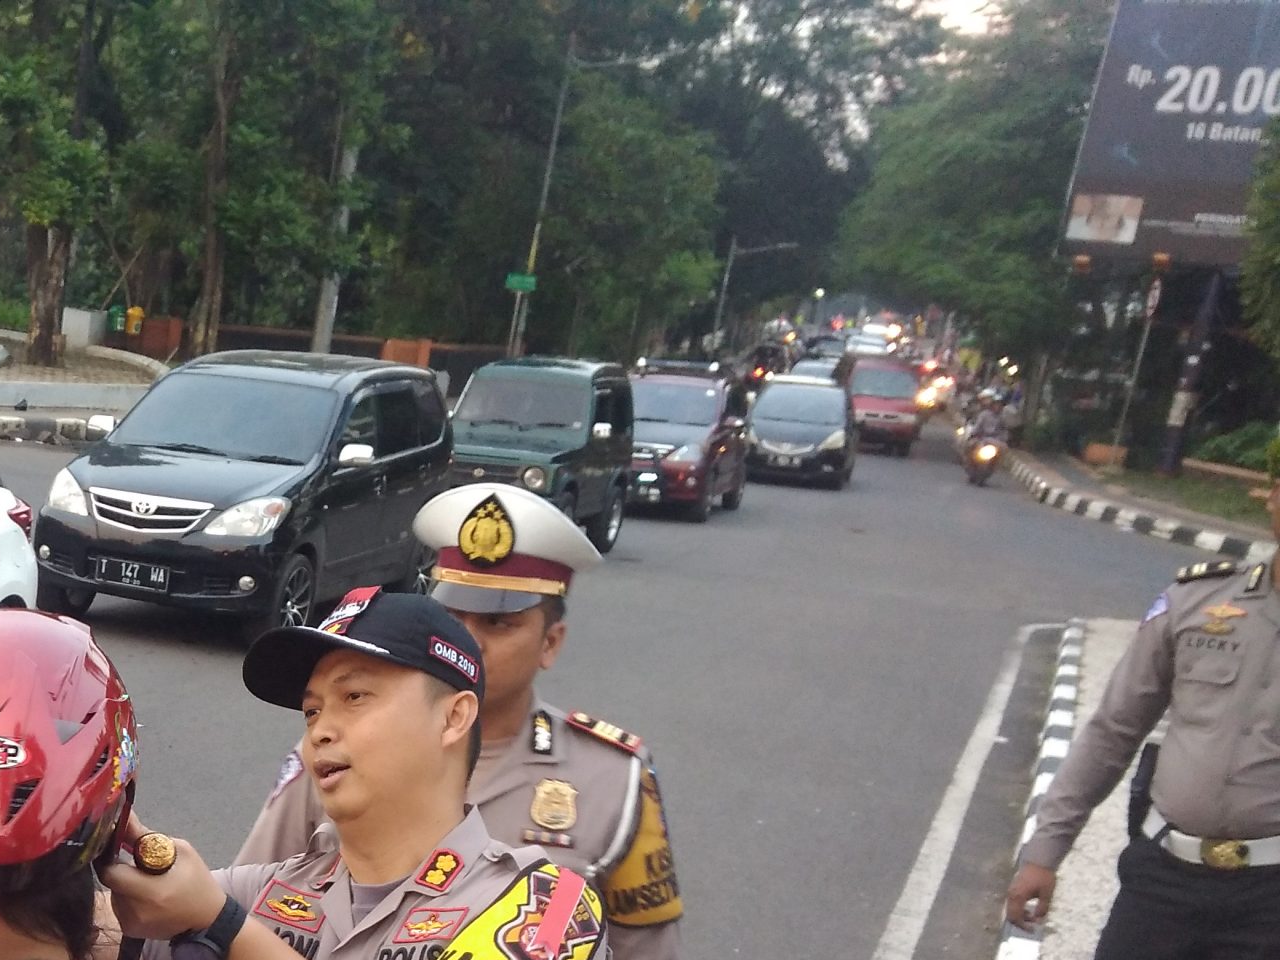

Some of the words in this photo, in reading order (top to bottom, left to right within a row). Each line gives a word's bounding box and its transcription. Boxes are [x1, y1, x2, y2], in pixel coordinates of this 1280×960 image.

[101, 559, 108, 574] T
[121, 562, 140, 578] 147
[150, 566, 165, 583] WA
[434, 642, 457, 664] OMB
[458, 655, 475, 677] 2019
